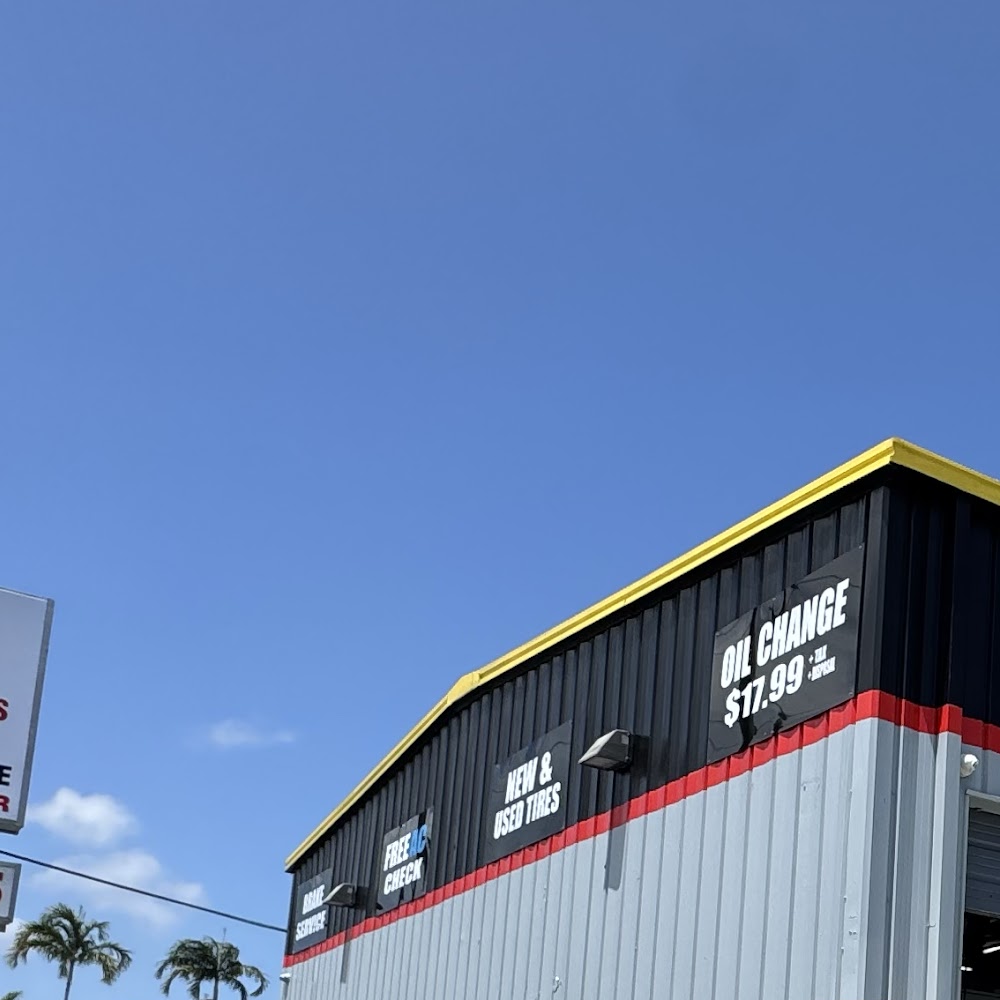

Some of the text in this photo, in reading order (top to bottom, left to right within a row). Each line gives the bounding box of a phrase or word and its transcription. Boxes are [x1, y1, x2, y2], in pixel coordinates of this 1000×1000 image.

[720, 578, 850, 689] OIL CHANGE
[724, 654, 805, 728] $17.99
[505, 751, 554, 805] NEW &
[493, 781, 562, 840] USED TIRES
[383, 823, 428, 872] FREE AC
[383, 856, 424, 896] CHECK
[295, 909, 327, 941] SERVICE
